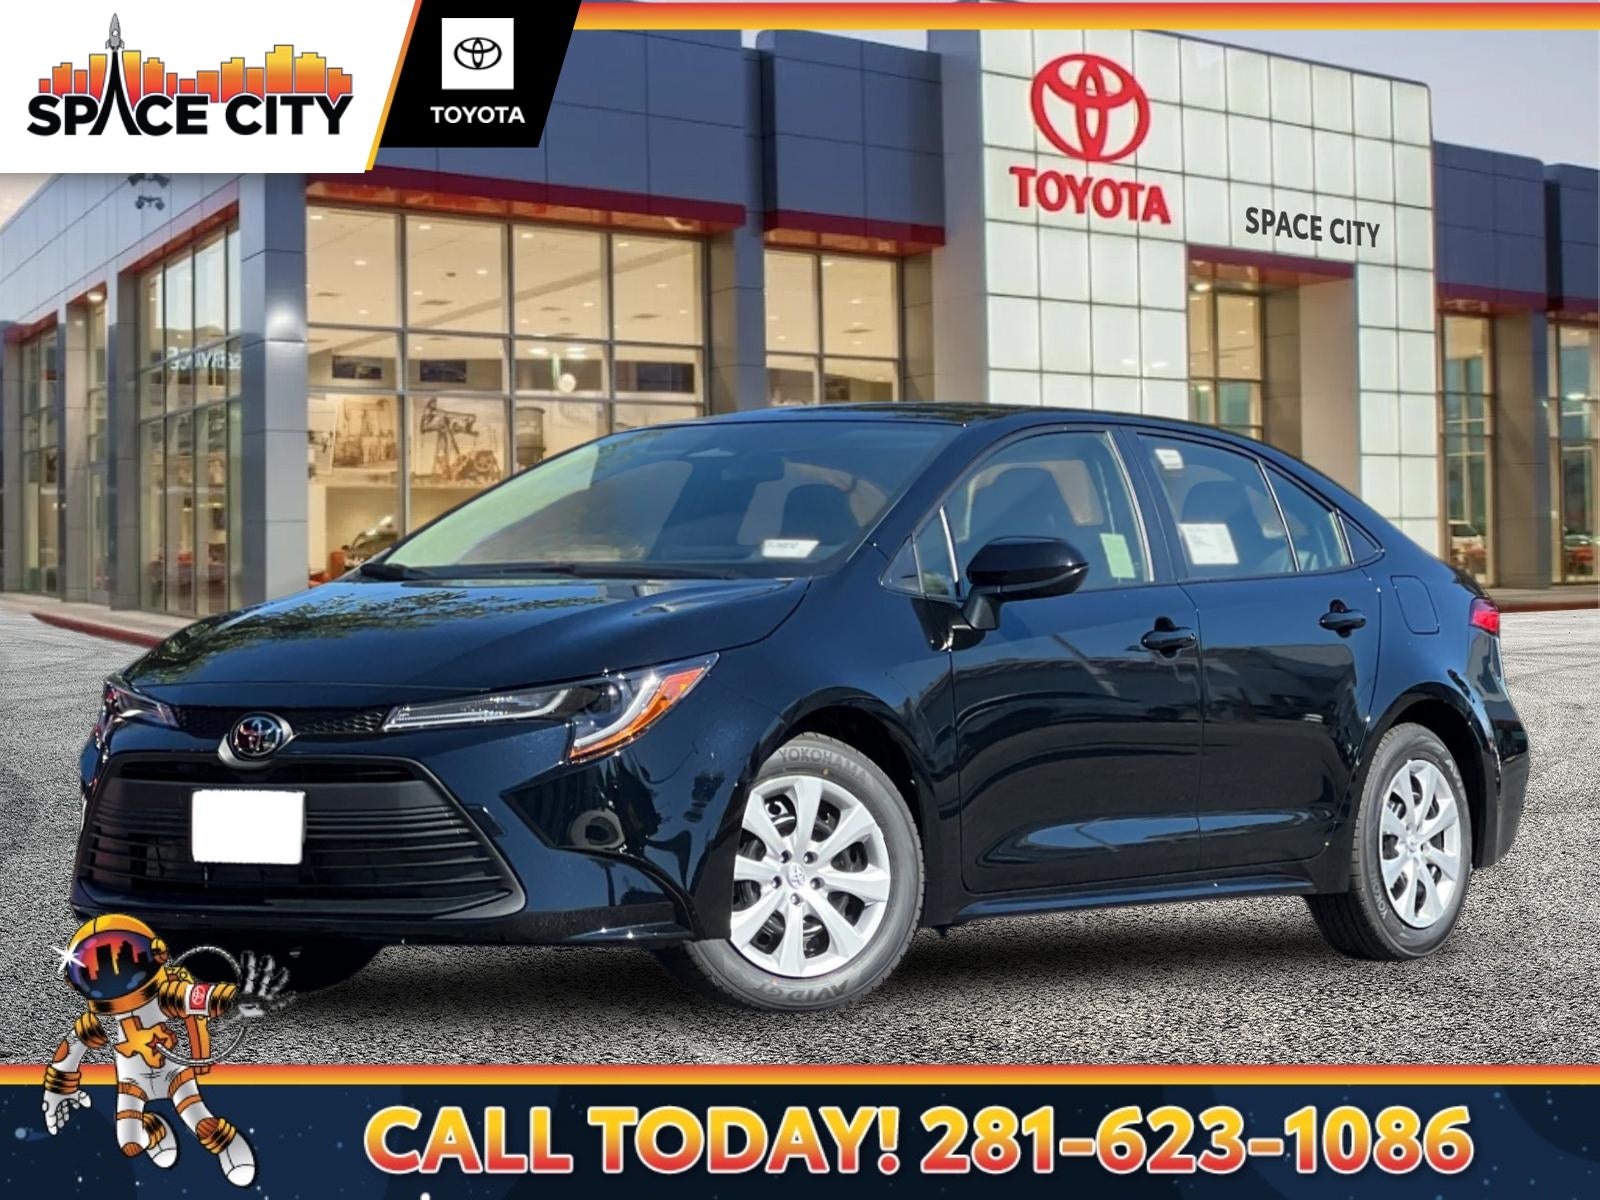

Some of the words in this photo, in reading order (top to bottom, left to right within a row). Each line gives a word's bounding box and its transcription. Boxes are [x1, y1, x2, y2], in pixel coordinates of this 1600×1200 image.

[1009, 165, 1171, 225] TOYOTA
[1245, 206, 1322, 242] SPACE
[1329, 218, 1381, 248] CITY
